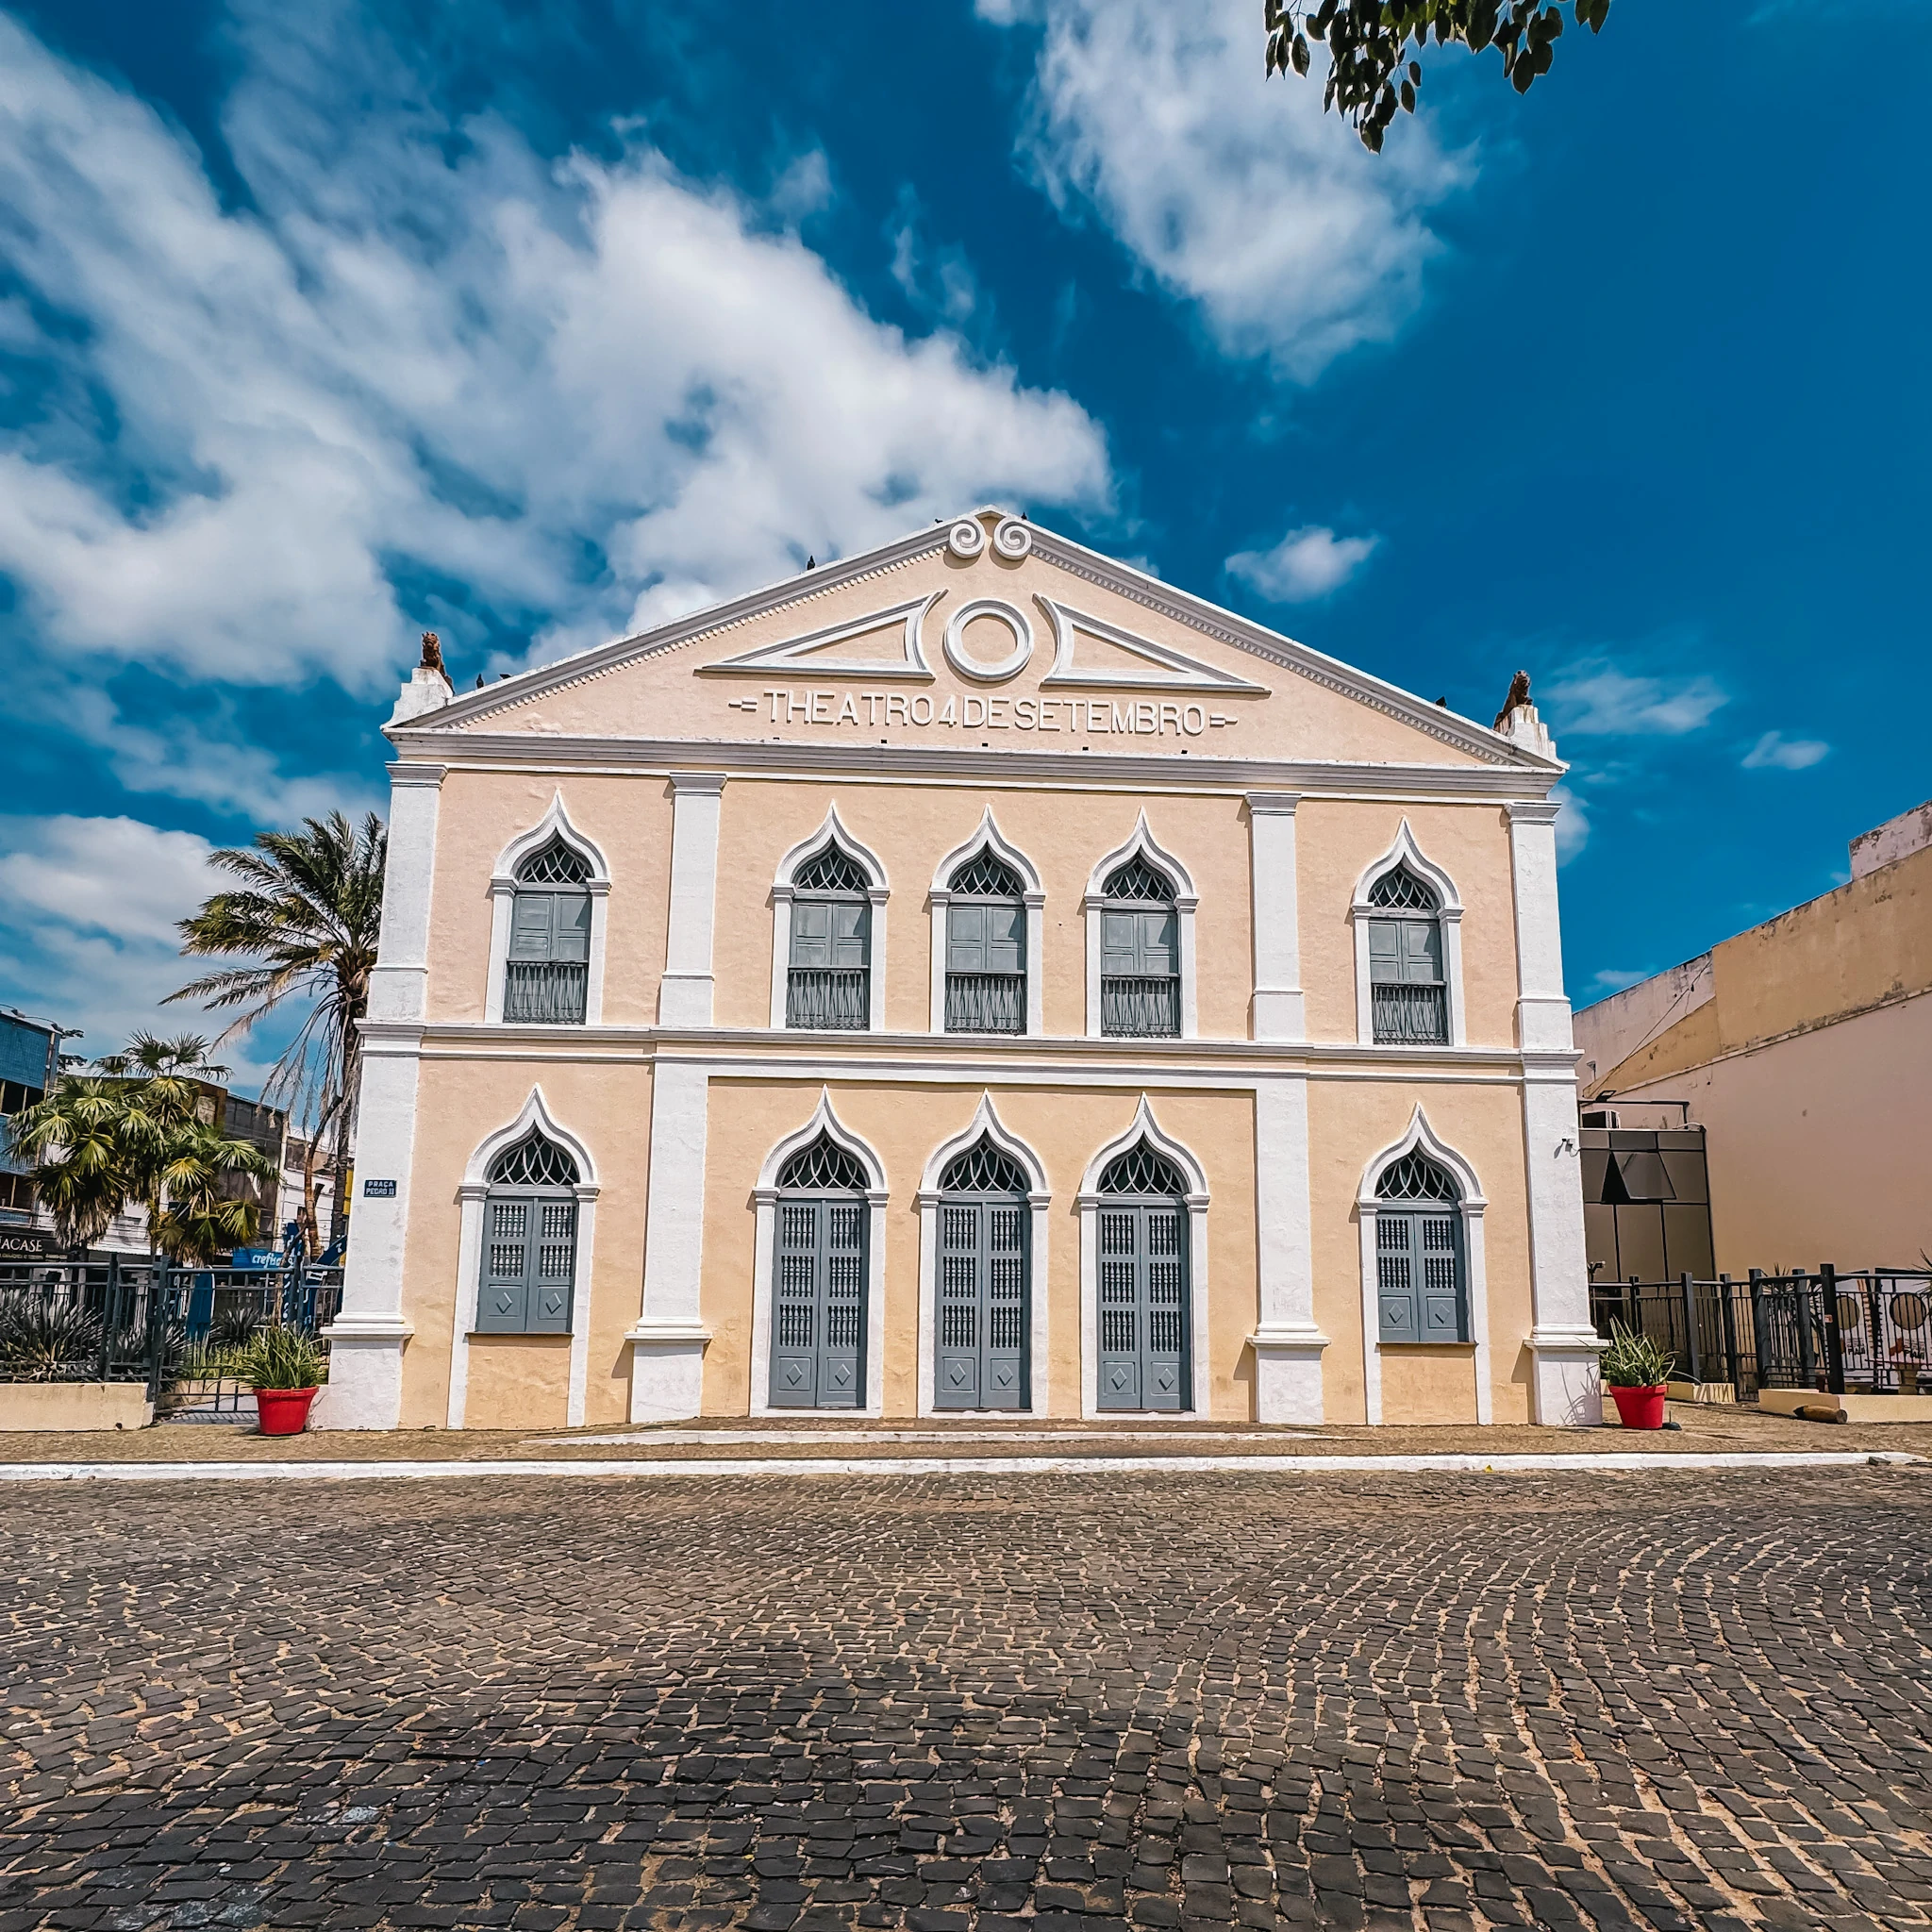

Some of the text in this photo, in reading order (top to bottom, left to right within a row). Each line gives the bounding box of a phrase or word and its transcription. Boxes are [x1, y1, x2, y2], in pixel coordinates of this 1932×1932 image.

[763, 688, 935, 726] THEATRO
[938, 694, 958, 728] 4
[1014, 697, 1206, 737] SETEMBRO
